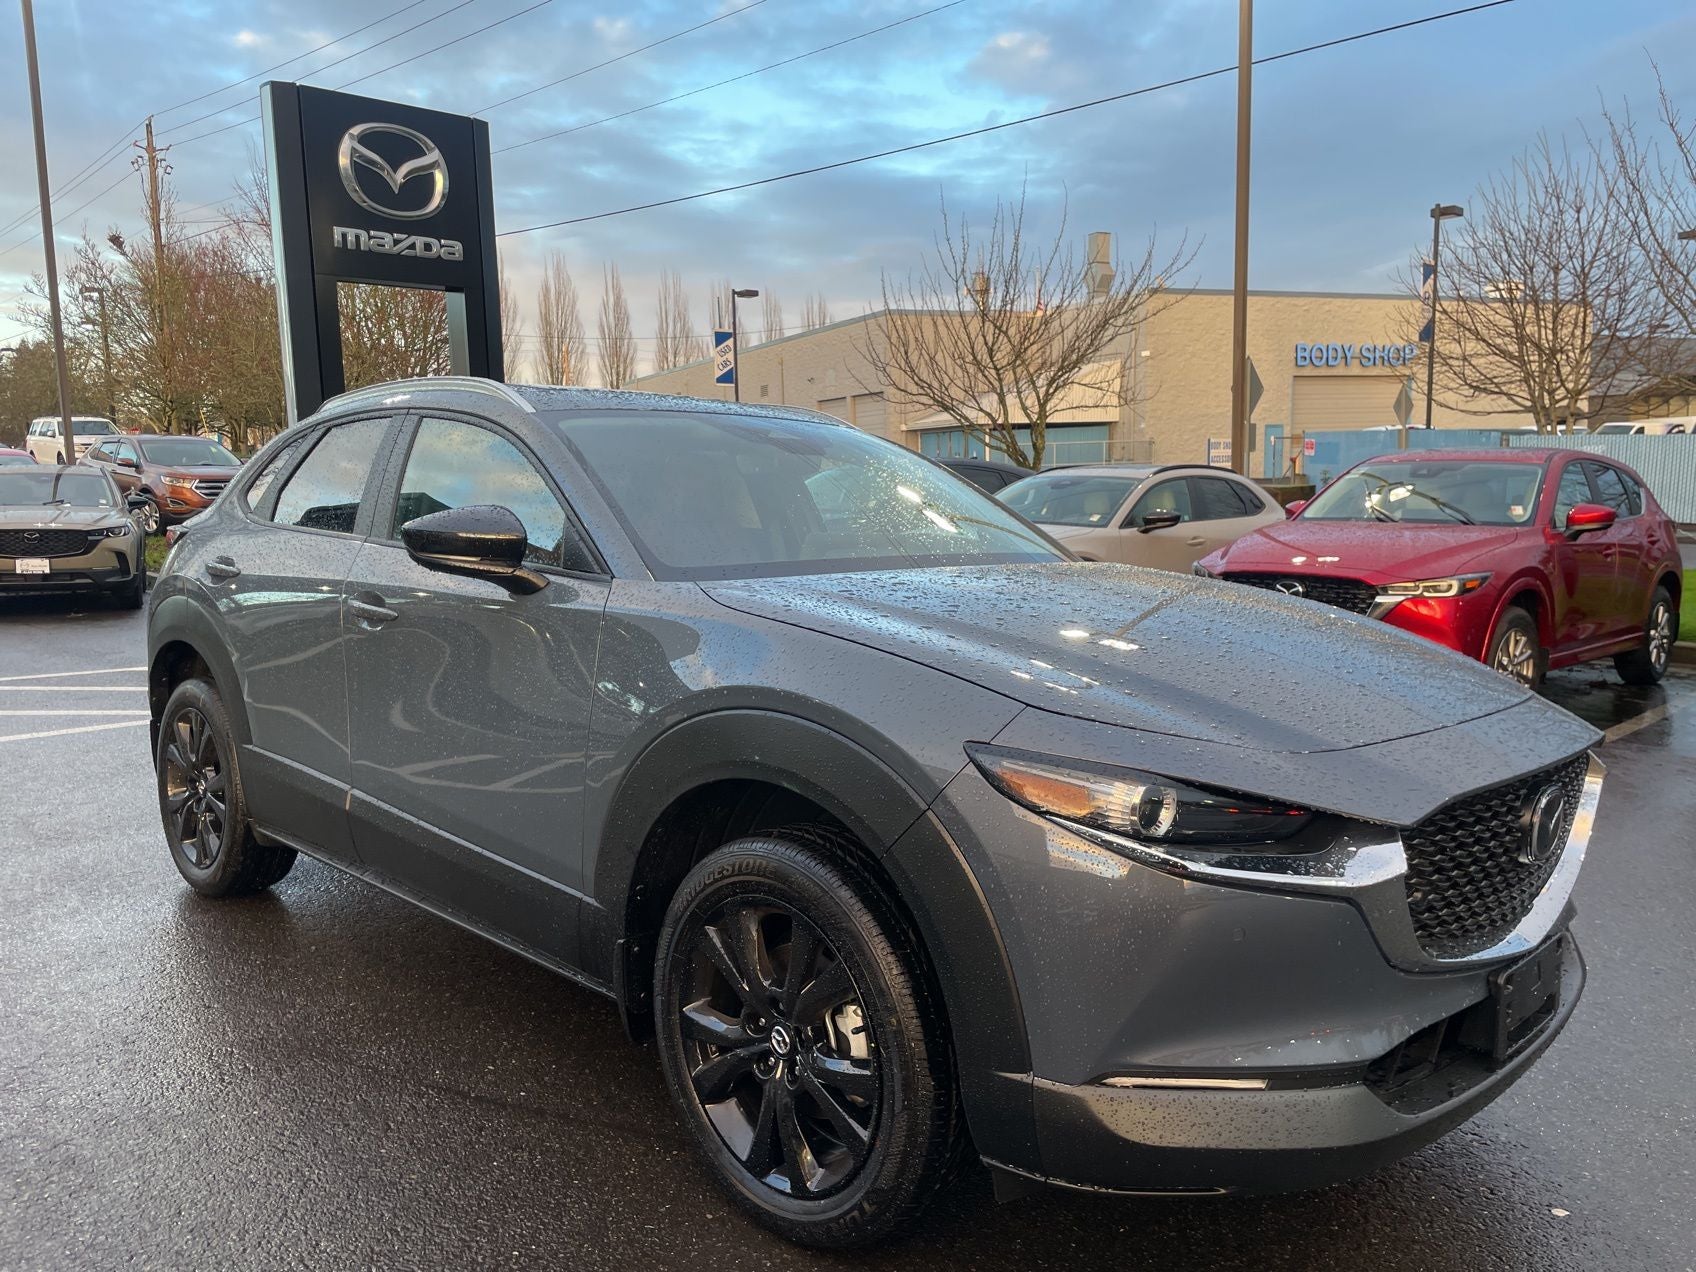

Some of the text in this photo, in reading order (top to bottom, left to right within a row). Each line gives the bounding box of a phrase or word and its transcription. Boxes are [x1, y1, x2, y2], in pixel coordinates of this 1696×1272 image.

[717, 344, 732, 358] USED
[1295, 343, 1417, 367] BODY SHOP
[717, 358, 732, 371] CARS
